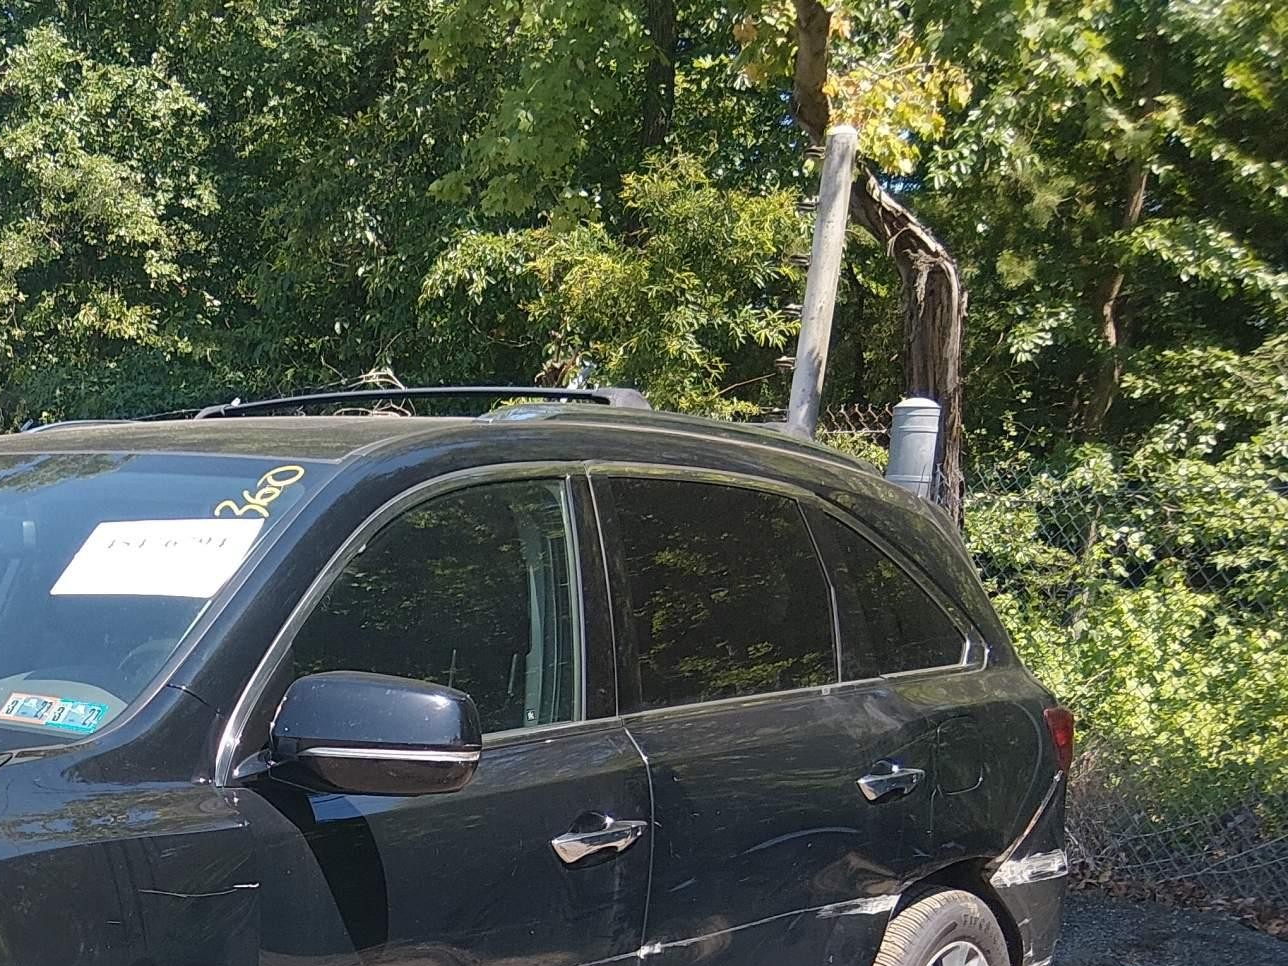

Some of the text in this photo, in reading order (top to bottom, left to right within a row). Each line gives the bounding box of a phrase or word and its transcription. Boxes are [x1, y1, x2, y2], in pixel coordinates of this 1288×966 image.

[214, 465, 305, 517] 360
[5, 700, 18, 715] 3
[52, 706, 65, 722] 3
